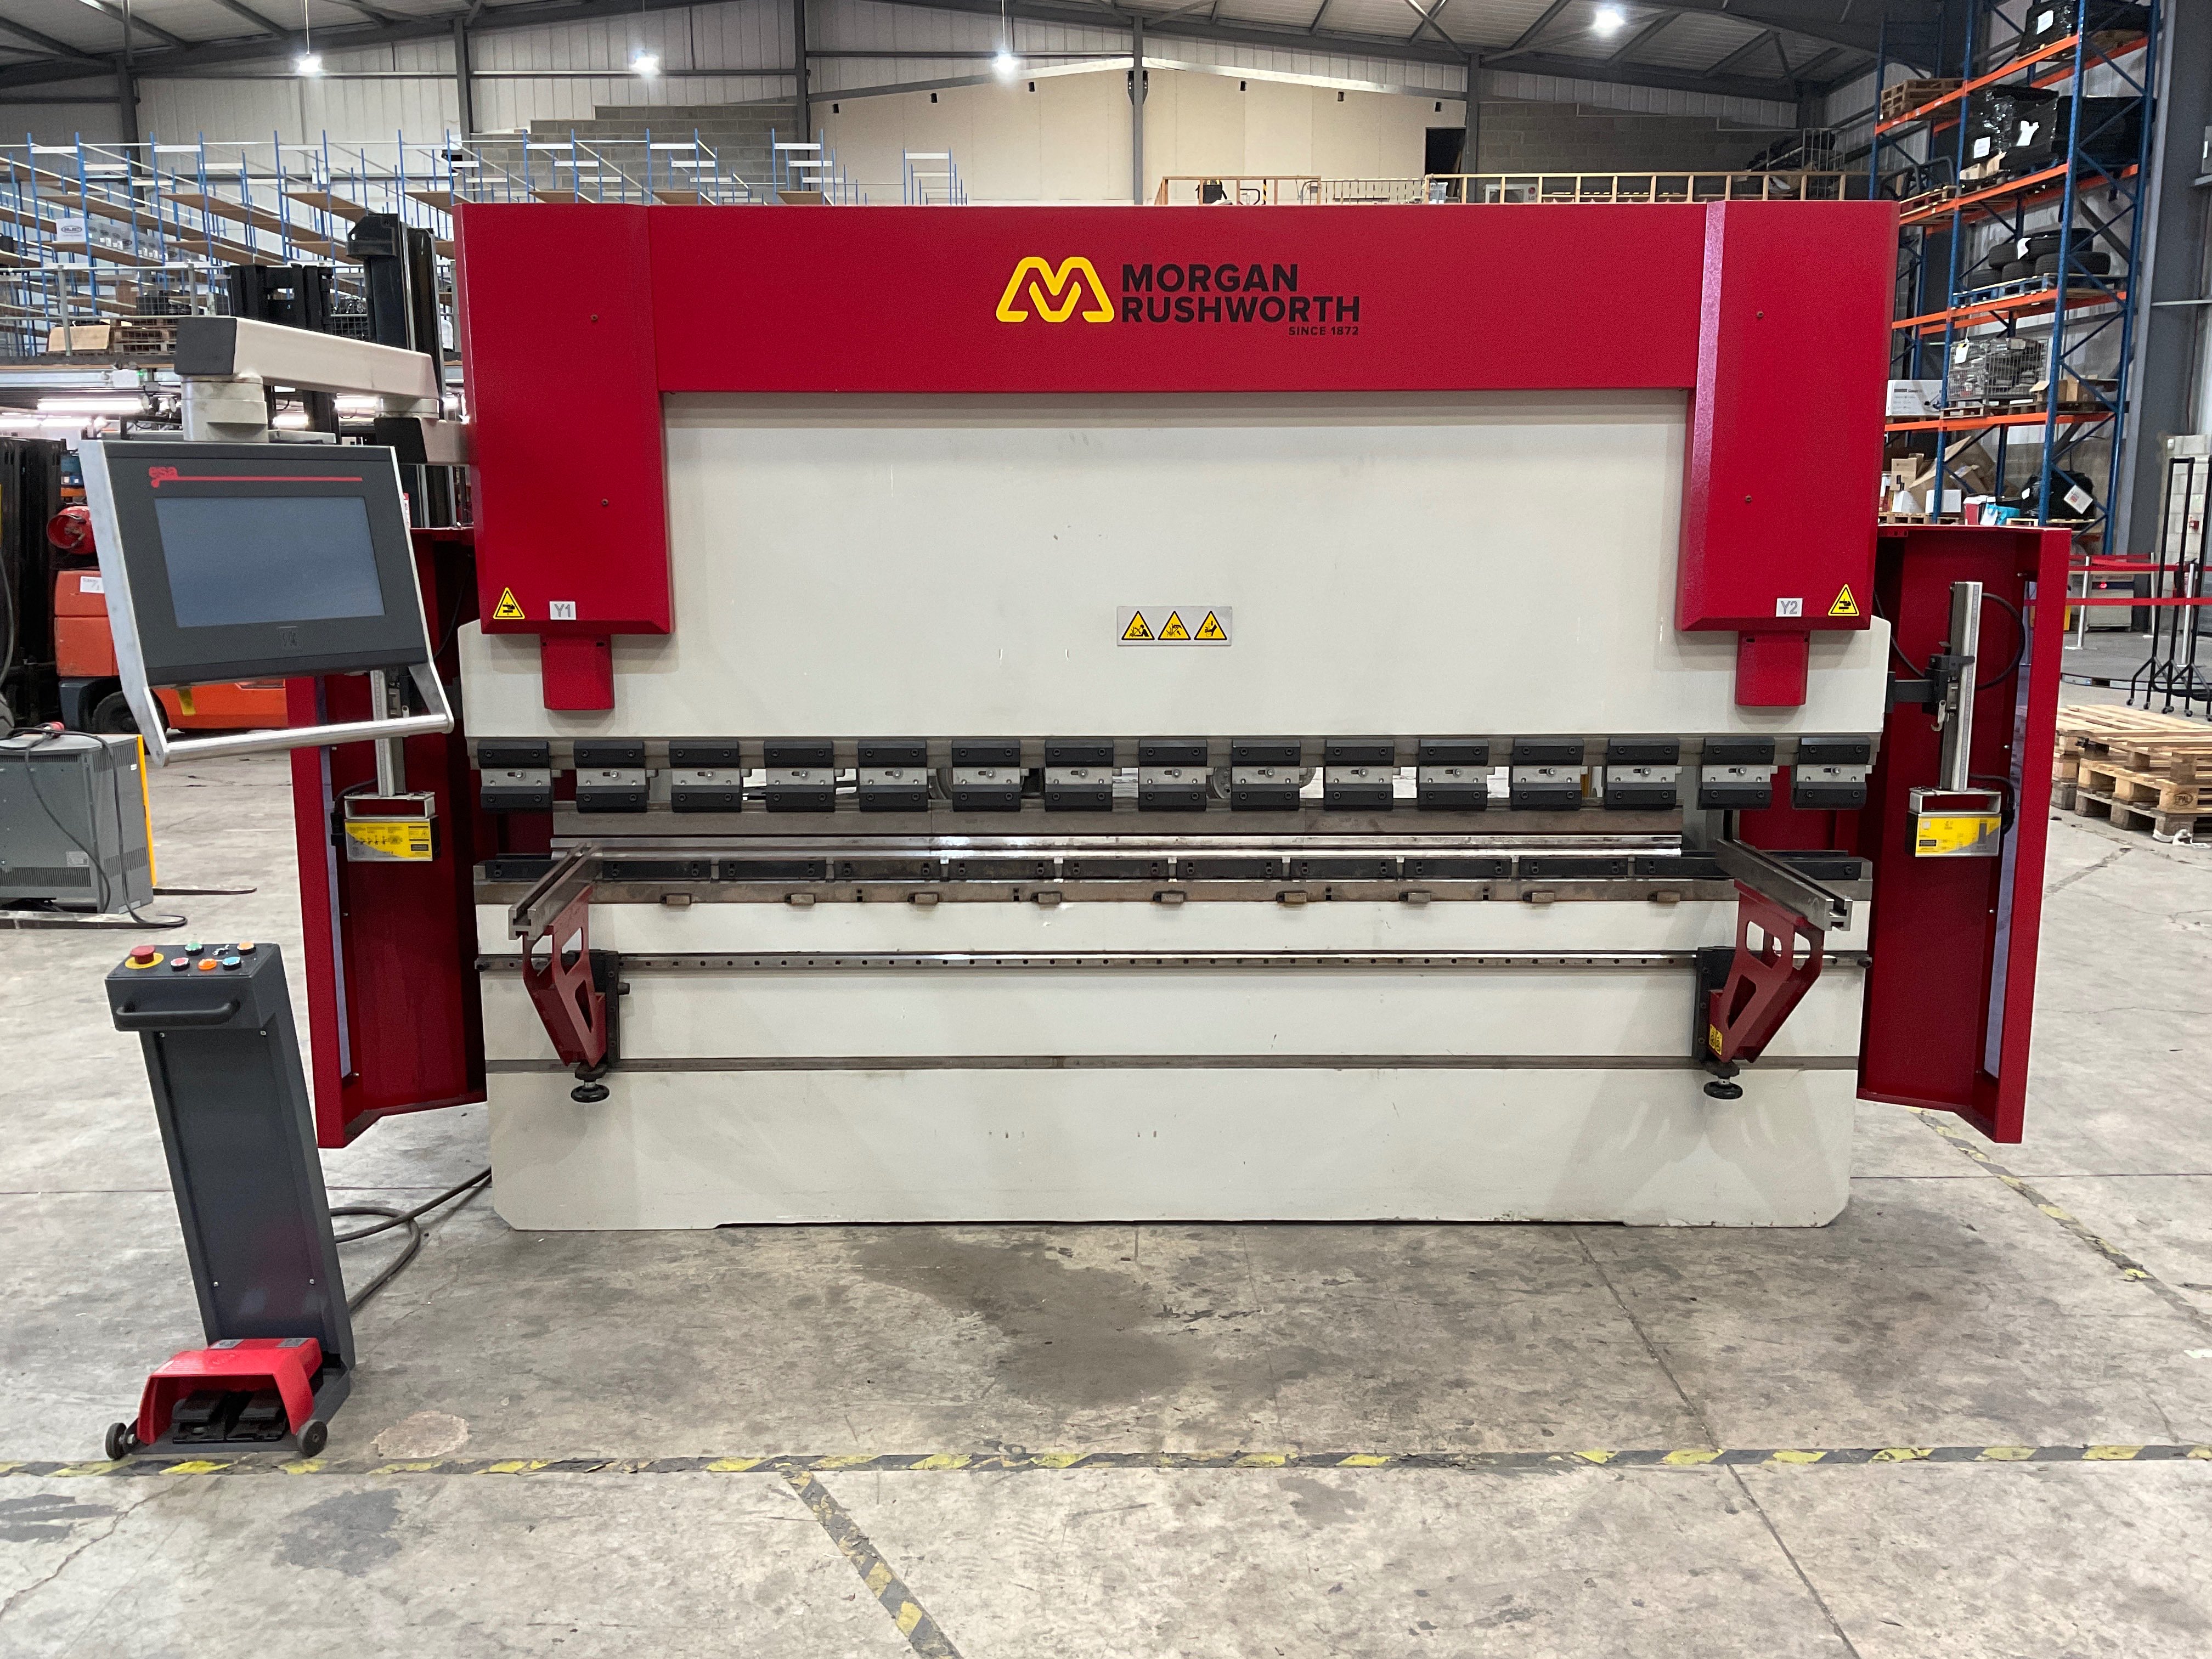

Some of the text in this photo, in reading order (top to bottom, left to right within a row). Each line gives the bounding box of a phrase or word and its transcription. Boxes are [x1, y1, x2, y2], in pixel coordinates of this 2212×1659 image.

[1122, 263, 1298, 292] MORGAN
[1121, 296, 1360, 323] RUSHWORTH
[1288, 326, 1359, 336] SINCE 1872
[554, 603, 571, 618] Y1
[1780, 601, 1798, 614] Y2
